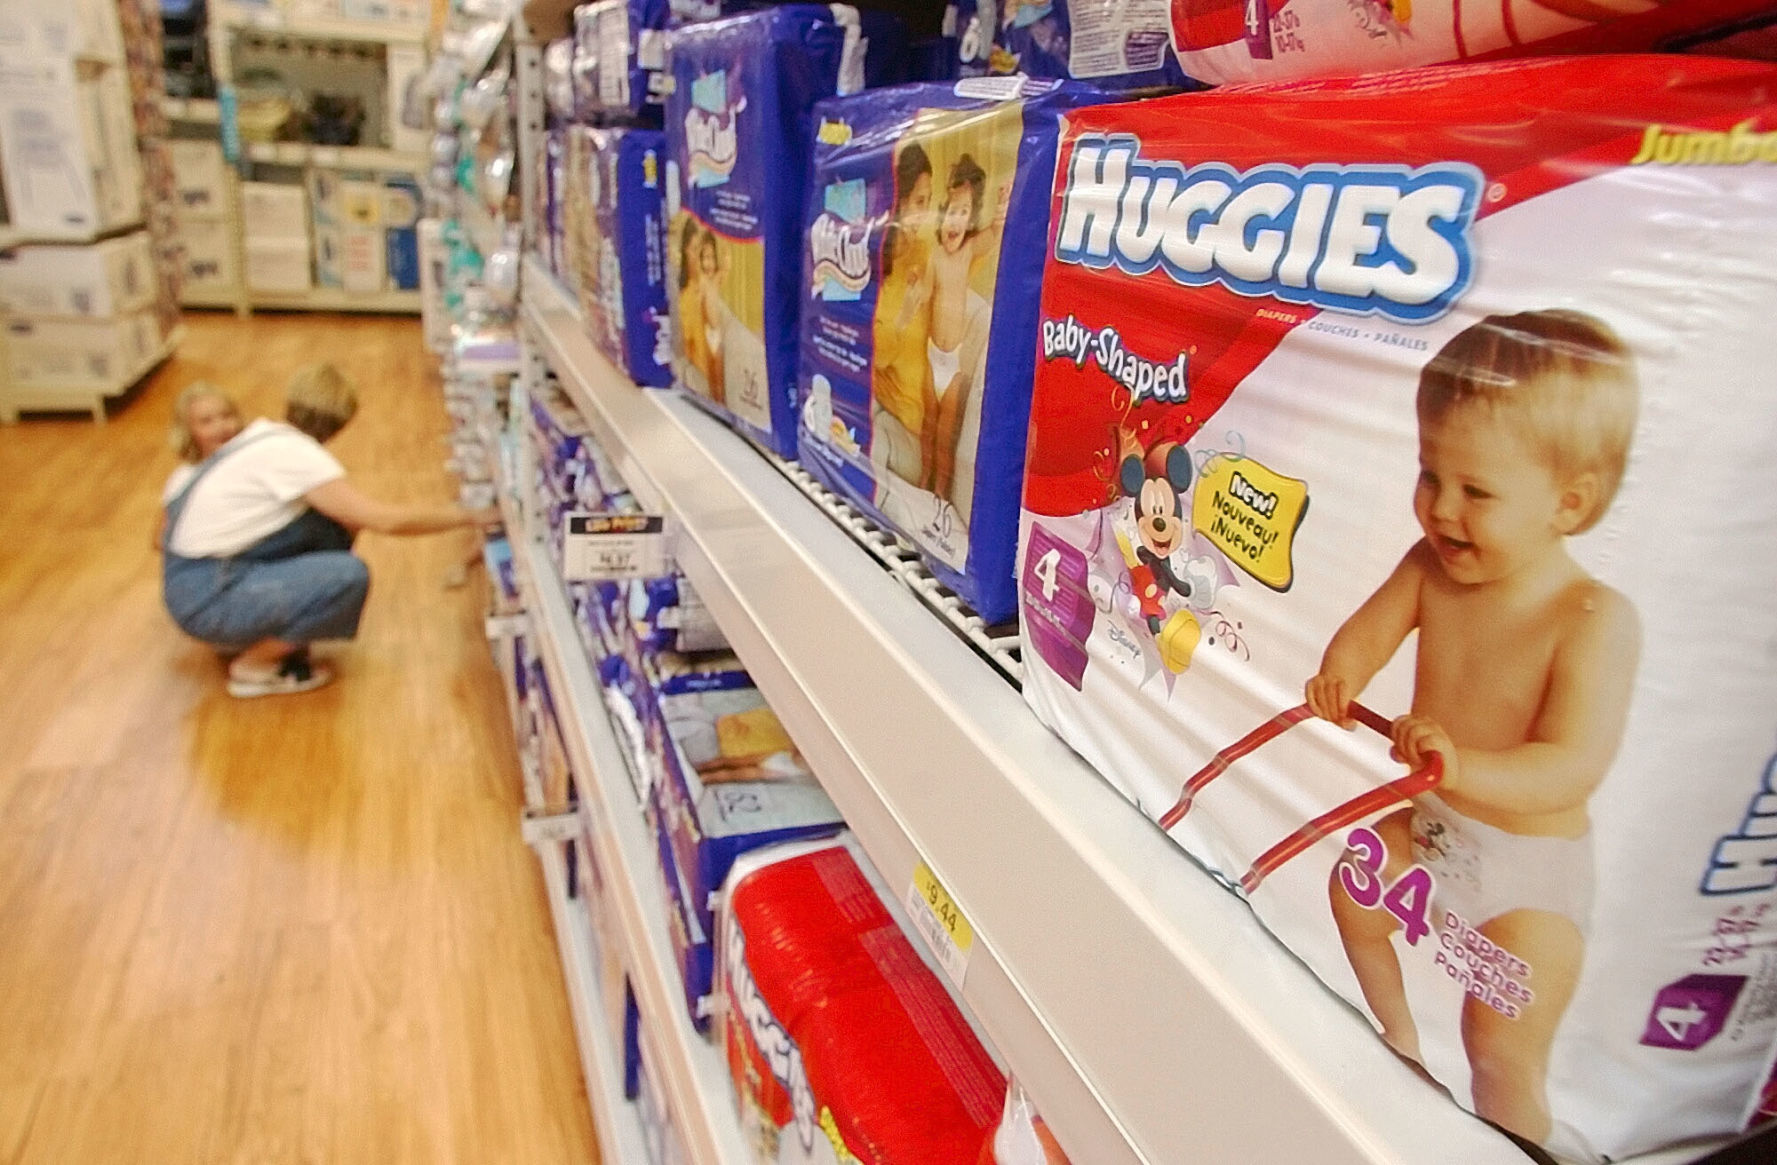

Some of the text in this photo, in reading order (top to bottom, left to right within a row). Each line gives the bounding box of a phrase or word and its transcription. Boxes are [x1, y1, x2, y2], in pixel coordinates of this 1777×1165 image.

[1245, 0, 1259, 35] 4
[1043, 312, 1187, 402] Baby-Shaped
[1308, 320, 1358, 339] COUCHES
[1212, 490, 1279, 549] Nouveau!
[1229, 472, 1278, 519] New!
[1034, 548, 1061, 602] 4
[1340, 828, 1432, 946] 34
[1440, 932, 1533, 1004] Couches
[1445, 911, 1530, 978] Diapers
[1434, 951, 1518, 1019] Pañales
[1656, 1003, 1707, 1041] 4
